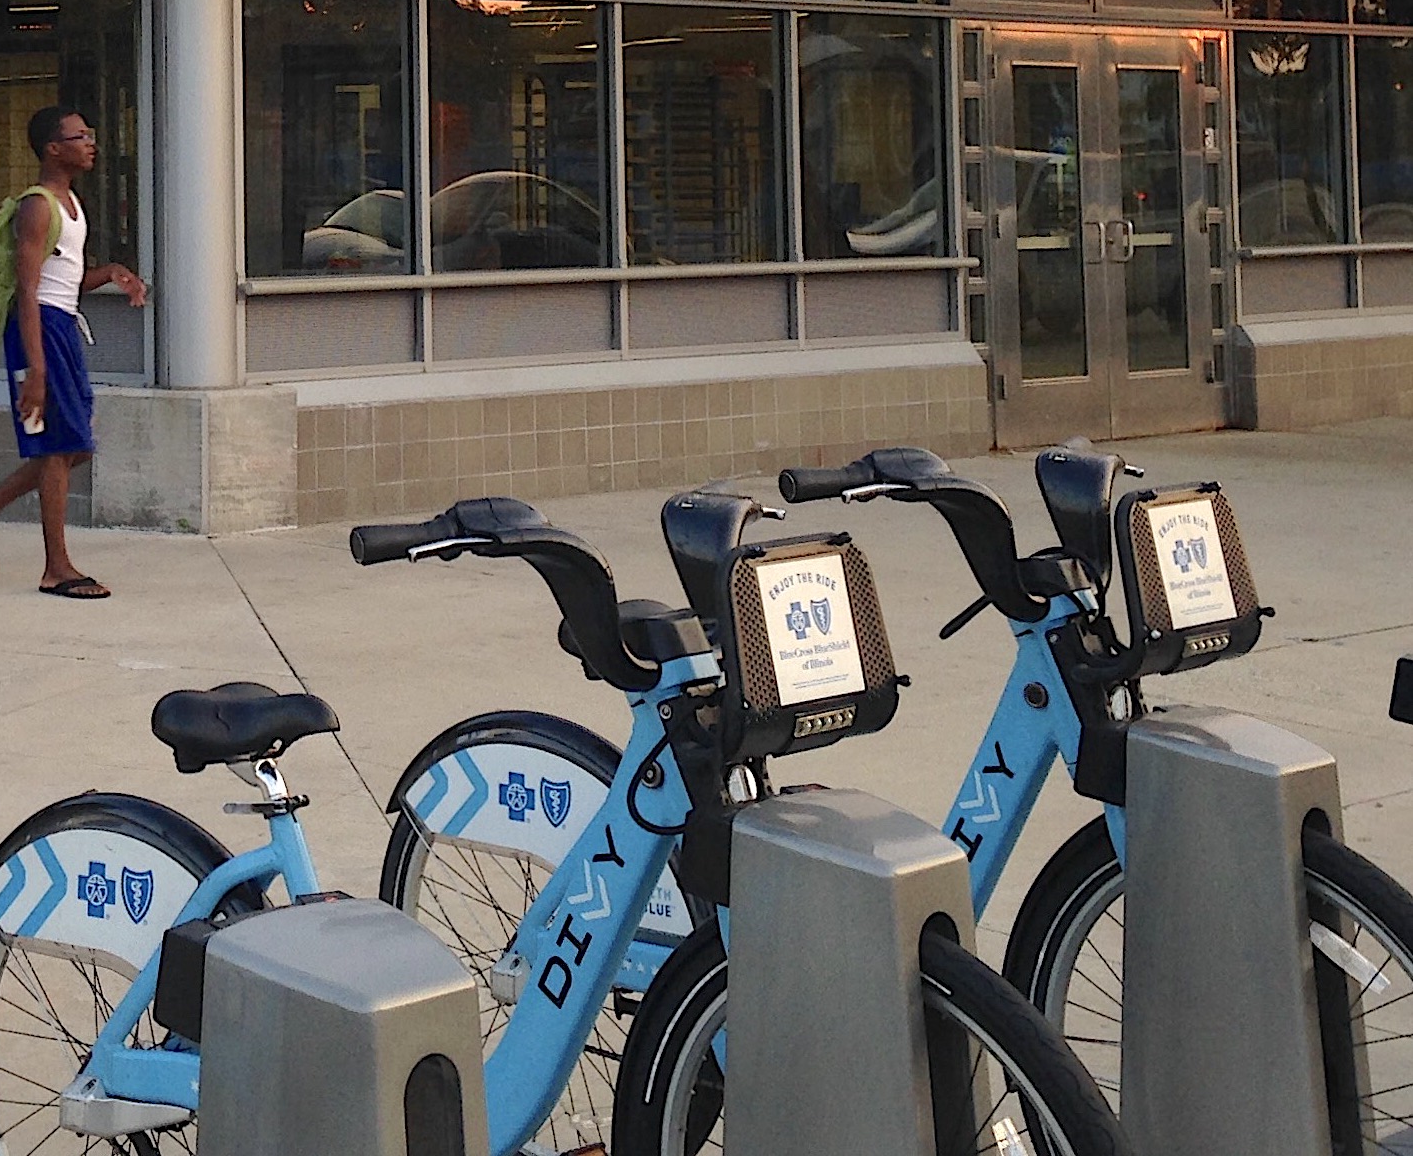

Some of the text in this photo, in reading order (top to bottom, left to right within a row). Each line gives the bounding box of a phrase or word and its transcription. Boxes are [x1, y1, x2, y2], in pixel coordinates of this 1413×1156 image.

[769, 572, 836, 600] ENJOY THE RIDE
[645, 902, 672, 918] LUE
